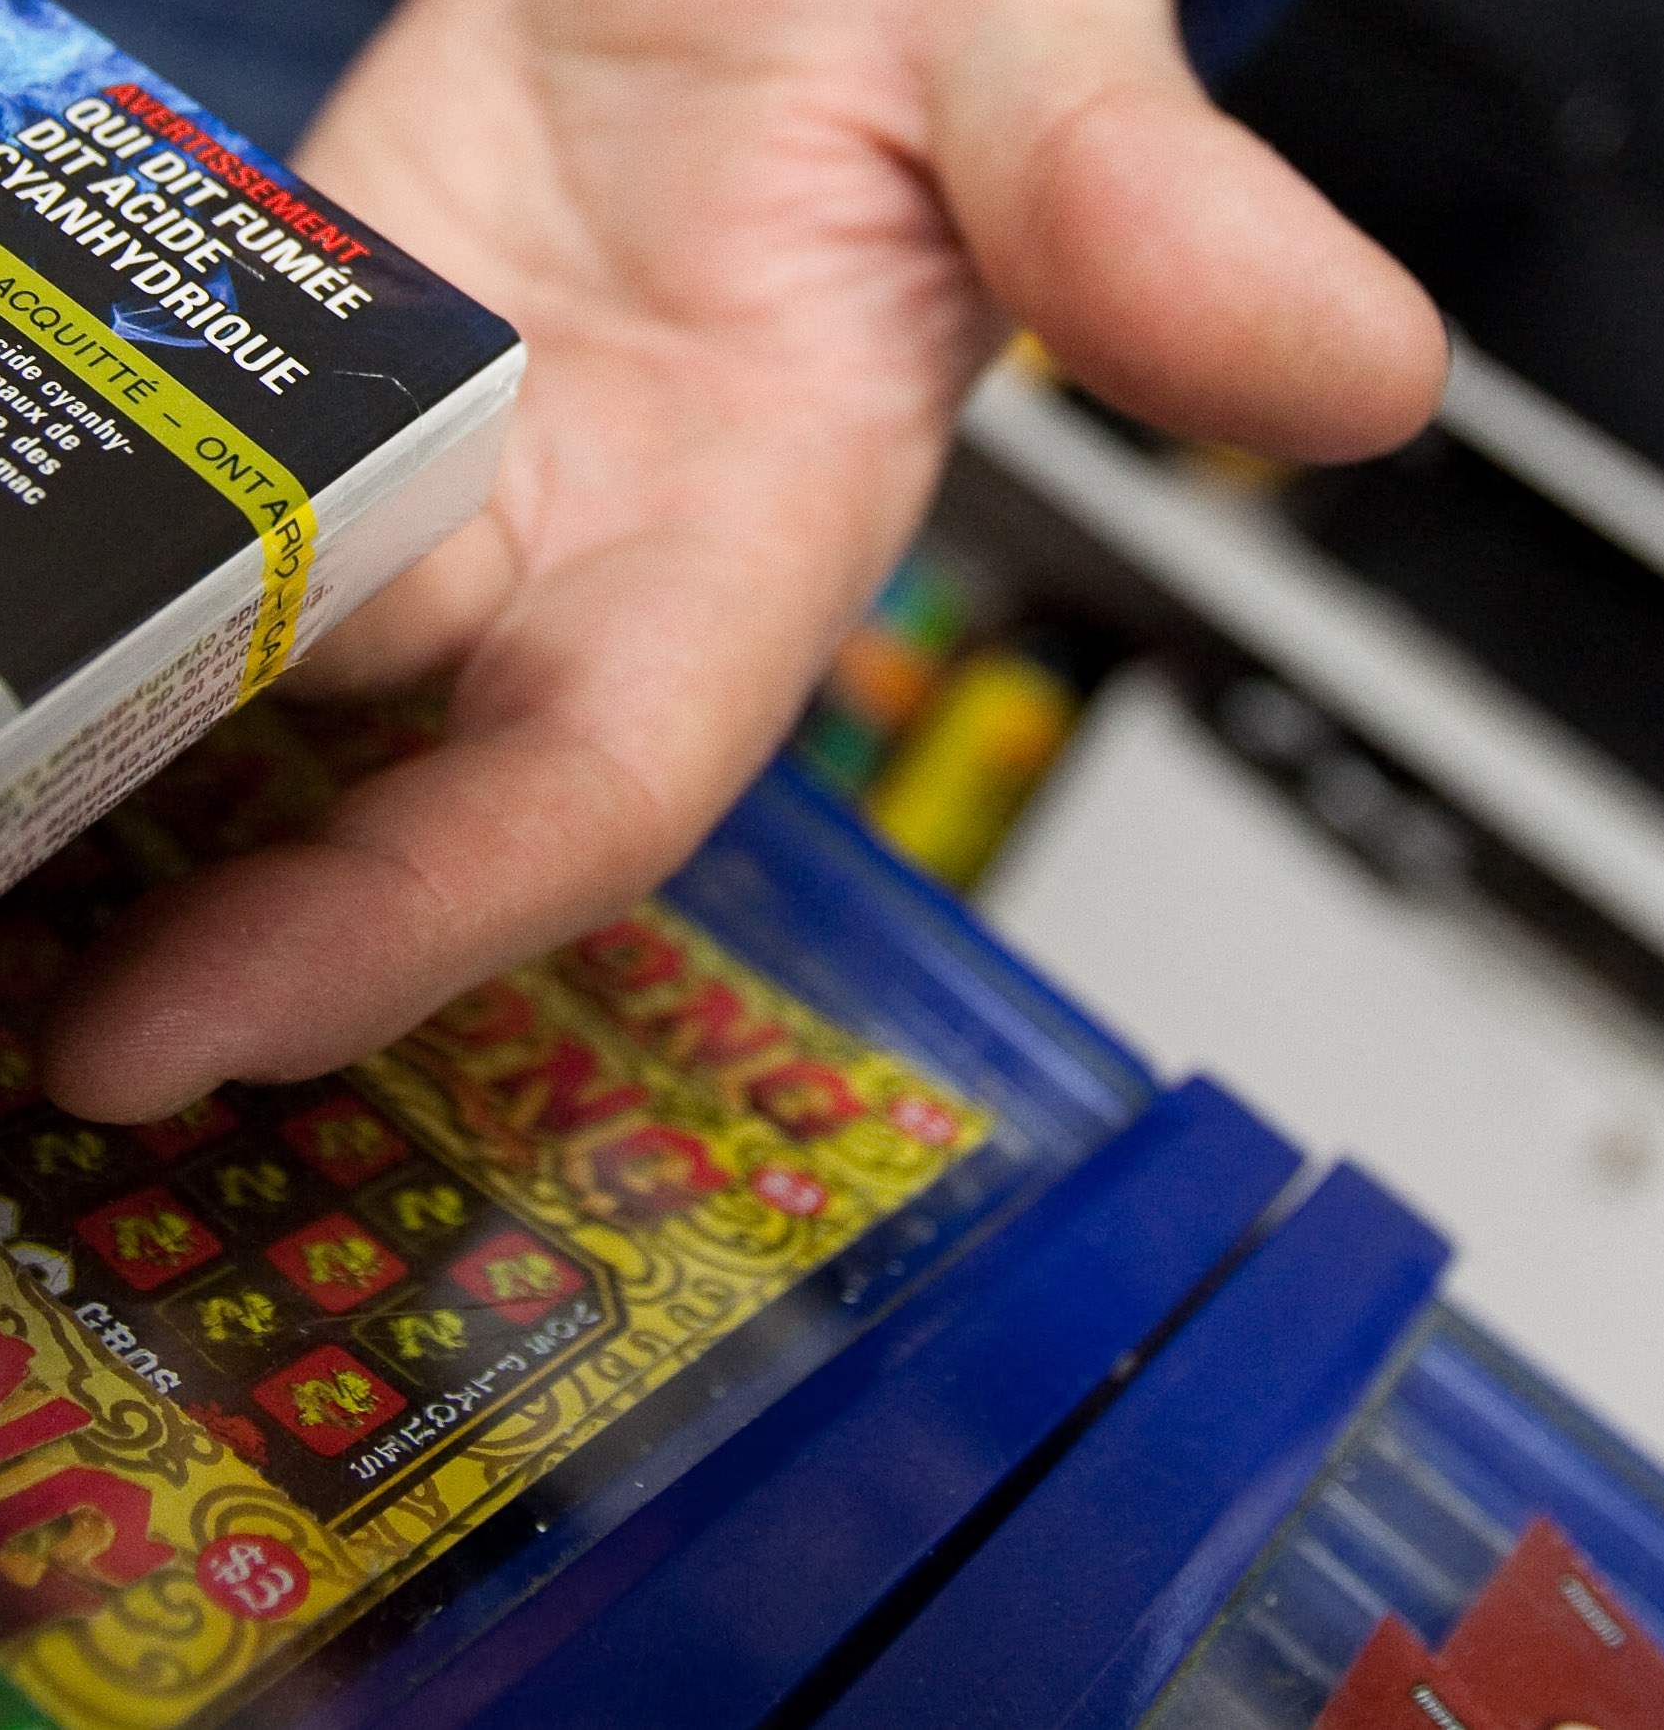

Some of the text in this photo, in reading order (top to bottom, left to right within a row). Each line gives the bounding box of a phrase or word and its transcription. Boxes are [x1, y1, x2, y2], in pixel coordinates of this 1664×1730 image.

[18, 119, 232, 273] DIT ACIDE
[63, 99, 372, 319] QUI DIT FUMÉE
[105, 85, 370, 262] AVERTISSEMENT
[11, 437, 61, 475] des
[41, 381, 133, 453] cyanhy-
[45, 423, 80, 450] de
[76, 1301, 183, 1397] GROS
